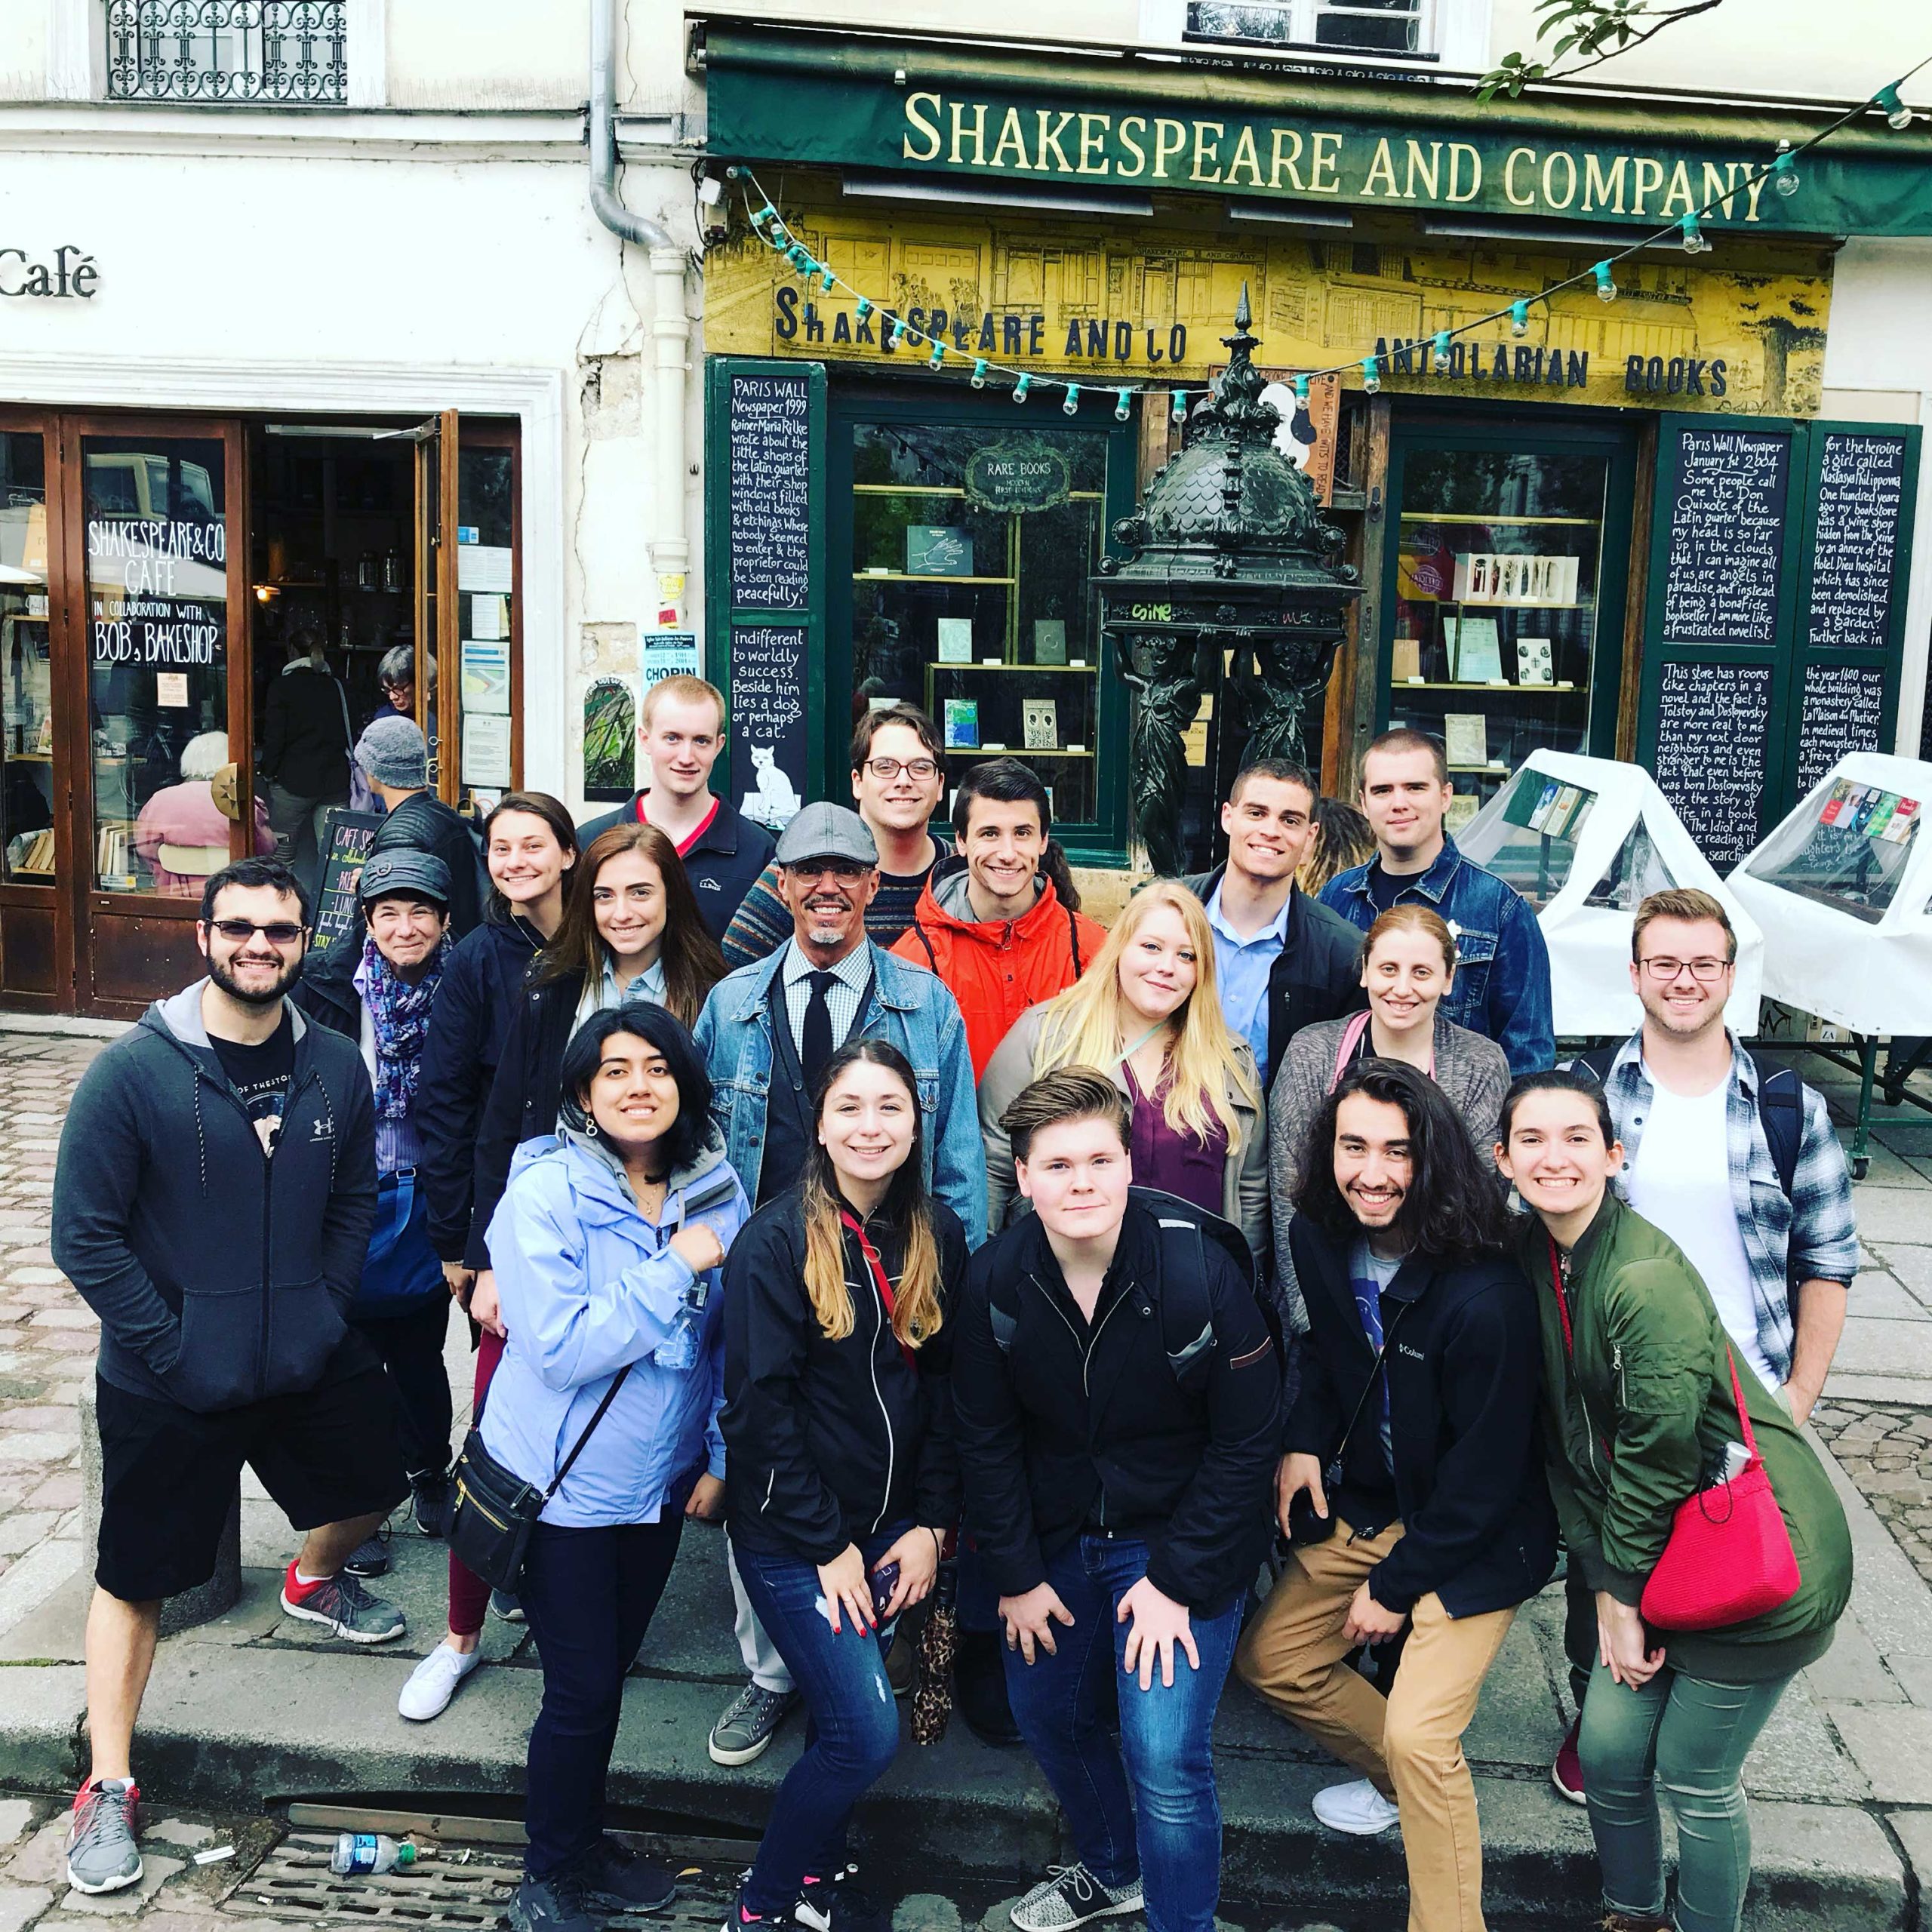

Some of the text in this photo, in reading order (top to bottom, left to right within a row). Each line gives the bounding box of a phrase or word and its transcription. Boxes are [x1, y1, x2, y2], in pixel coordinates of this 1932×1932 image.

[904, 92, 1770, 222] SHAKESPEARE AND COMPANY
[0, 245, 98, 297] Café
[1064, 318, 1131, 360] AND
[1626, 355, 1727, 397] BOOKS
[734, 379, 807, 398] PARIS WALL
[732, 398, 806, 415] Newspaper 1999
[731, 418, 808, 435] Rainer Maria Rilke
[732, 435, 808, 449] wrote about the
[1682, 432, 1783, 458] Paris Wall Newspaper
[732, 447, 807, 466] little shops of
[1823, 454, 1893, 471] a girl called
[732, 460, 808, 478] the latin quarter
[988, 463, 1051, 475] RARE BOOKS
[732, 475, 808, 492] with their shop
[1683, 470, 1776, 490] Some people call
[732, 491, 808, 505] windows filled
[1713, 488, 1734, 499] the
[1738, 487, 1763, 500] Don
[732, 500, 800, 517] with old books
[1678, 495, 1769, 515] Quixote of the
[734, 515, 740, 525] &
[785, 519, 808, 531] Where
[1818, 515, 1894, 533] was a wine shop
[732, 531, 807, 545] nobody seemed
[734, 543, 806, 558] to enter & the
[1676, 540, 1774, 555] up in the clouds
[734, 557, 808, 571] proprietor could
[125, 560, 176, 596] CAFE
[734, 571, 808, 592] be seen reading
[94, 601, 202, 621] IN COLLABORATION WITH
[1810, 604, 1885, 622] and replaced by
[1823, 616, 1829, 626] a
[145, 623, 218, 664] BAKESHOP
[735, 629, 803, 648] indifferent
[1810, 628, 1882, 645] Further back in
[734, 648, 799, 667] to worldly
[646, 668, 695, 680] CHOPIN
[1664, 664, 1769, 679] This store has rooms
[1807, 666, 1880, 685] the year 1600 our
[732, 679, 800, 695] Beside him
[1805, 681, 1881, 700] whole building was
[734, 694, 802, 718] lies a dog
[733, 710, 793, 727] or perhaps
[1660, 718, 1764, 733] are more real to me
[742, 724, 786, 739] a cat.
[1660, 731, 1761, 746] than my next door
[336, 826, 358, 849] CAFE
[334, 896, 357, 915] LUNC
[253, 1081, 270, 1091] THE
